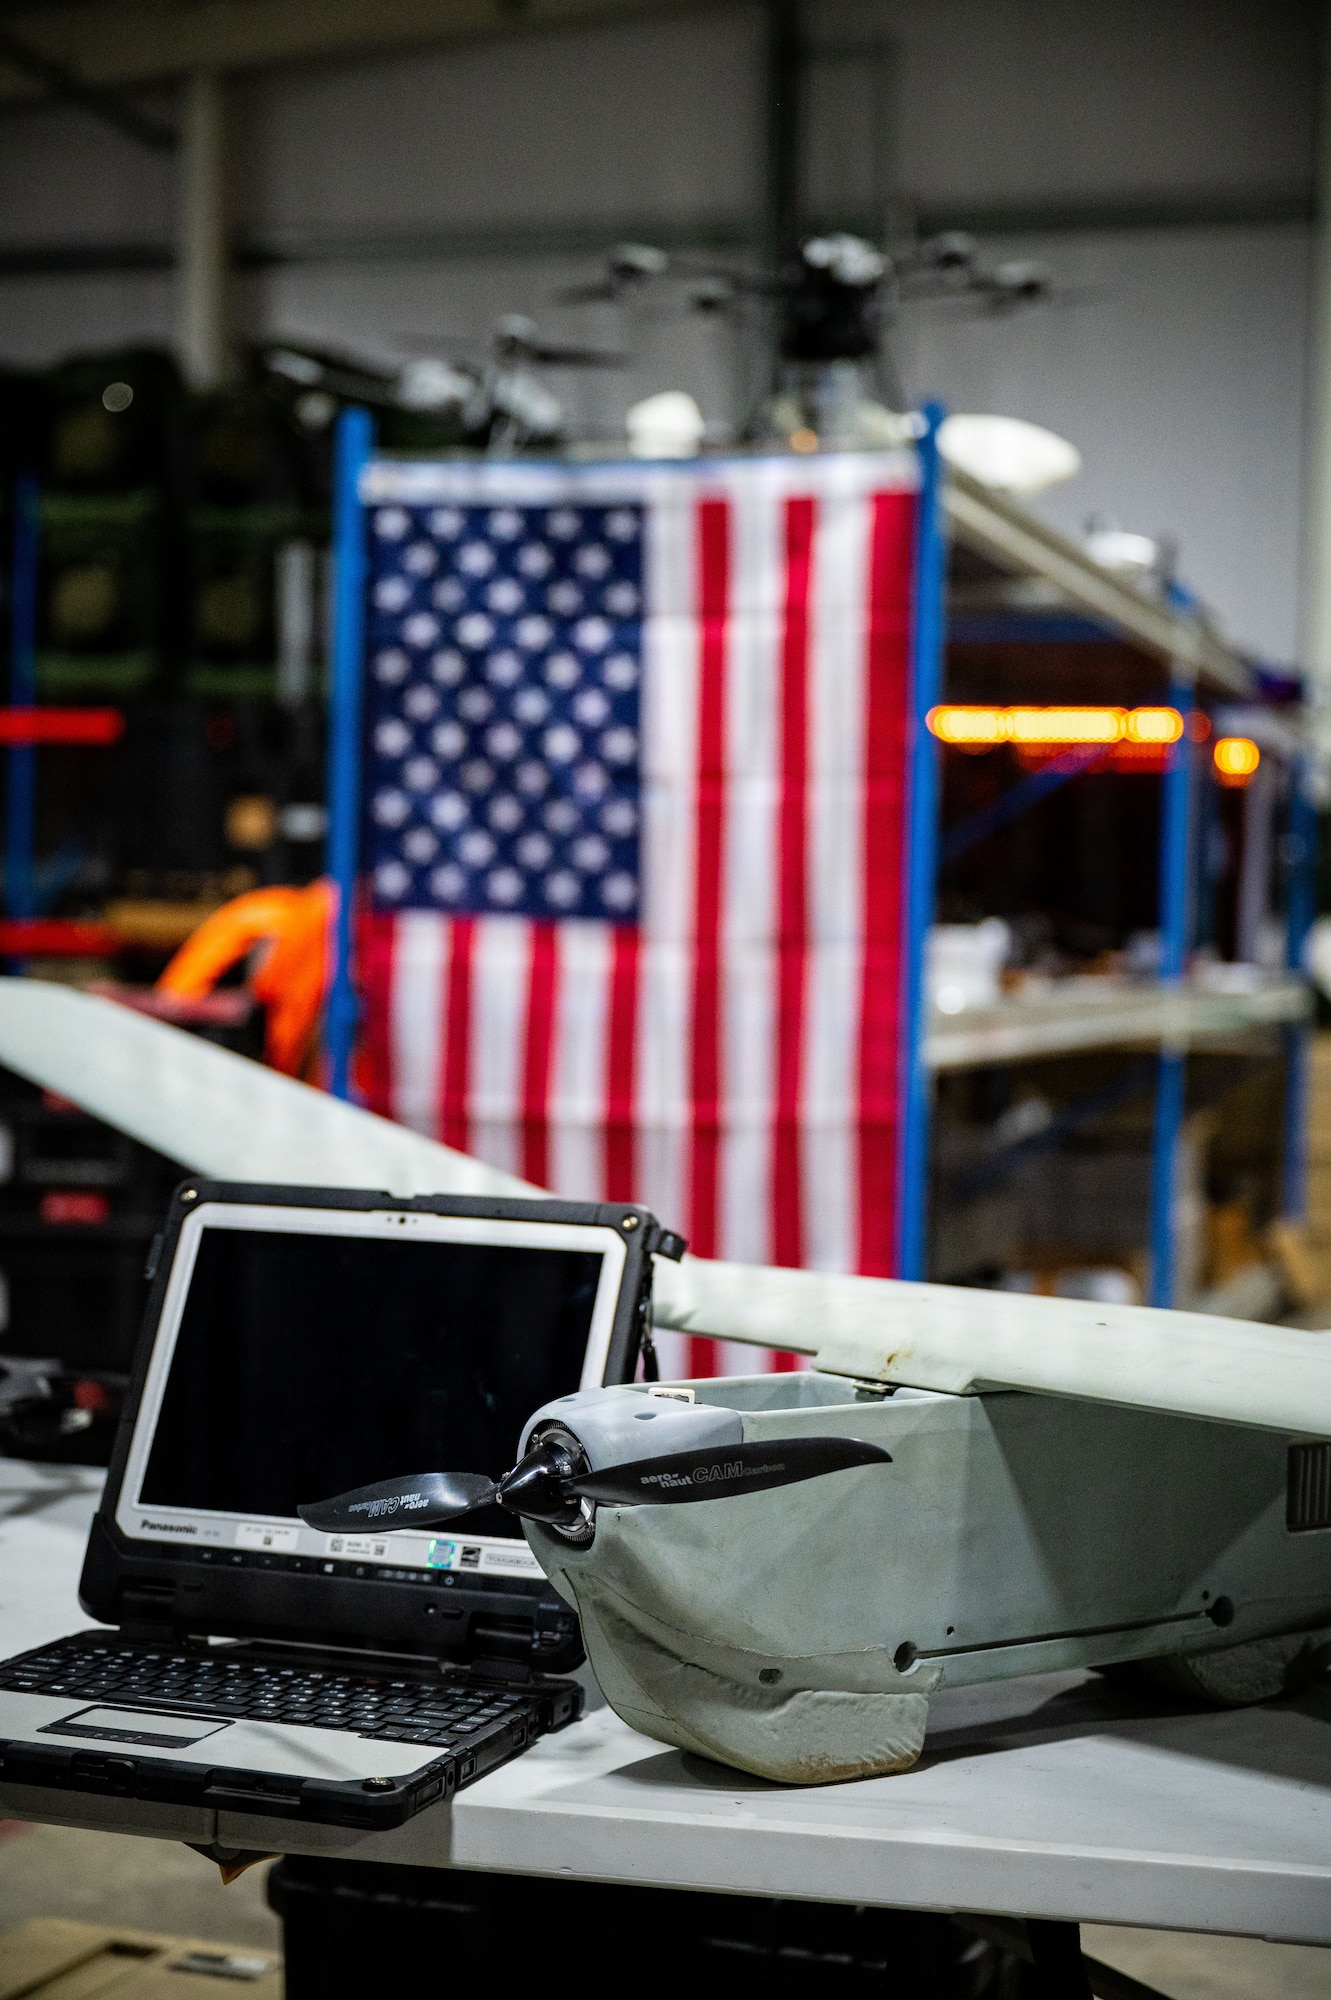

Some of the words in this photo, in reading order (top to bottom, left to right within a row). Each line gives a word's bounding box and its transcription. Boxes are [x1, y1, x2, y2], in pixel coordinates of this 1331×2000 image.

[640, 1472, 679, 1485] aero-
[660, 1475, 693, 1488] naut
[692, 1461, 743, 1484] CAM
[400, 1492, 421, 1506] naut
[141, 1519, 198, 1535] Panasonic
